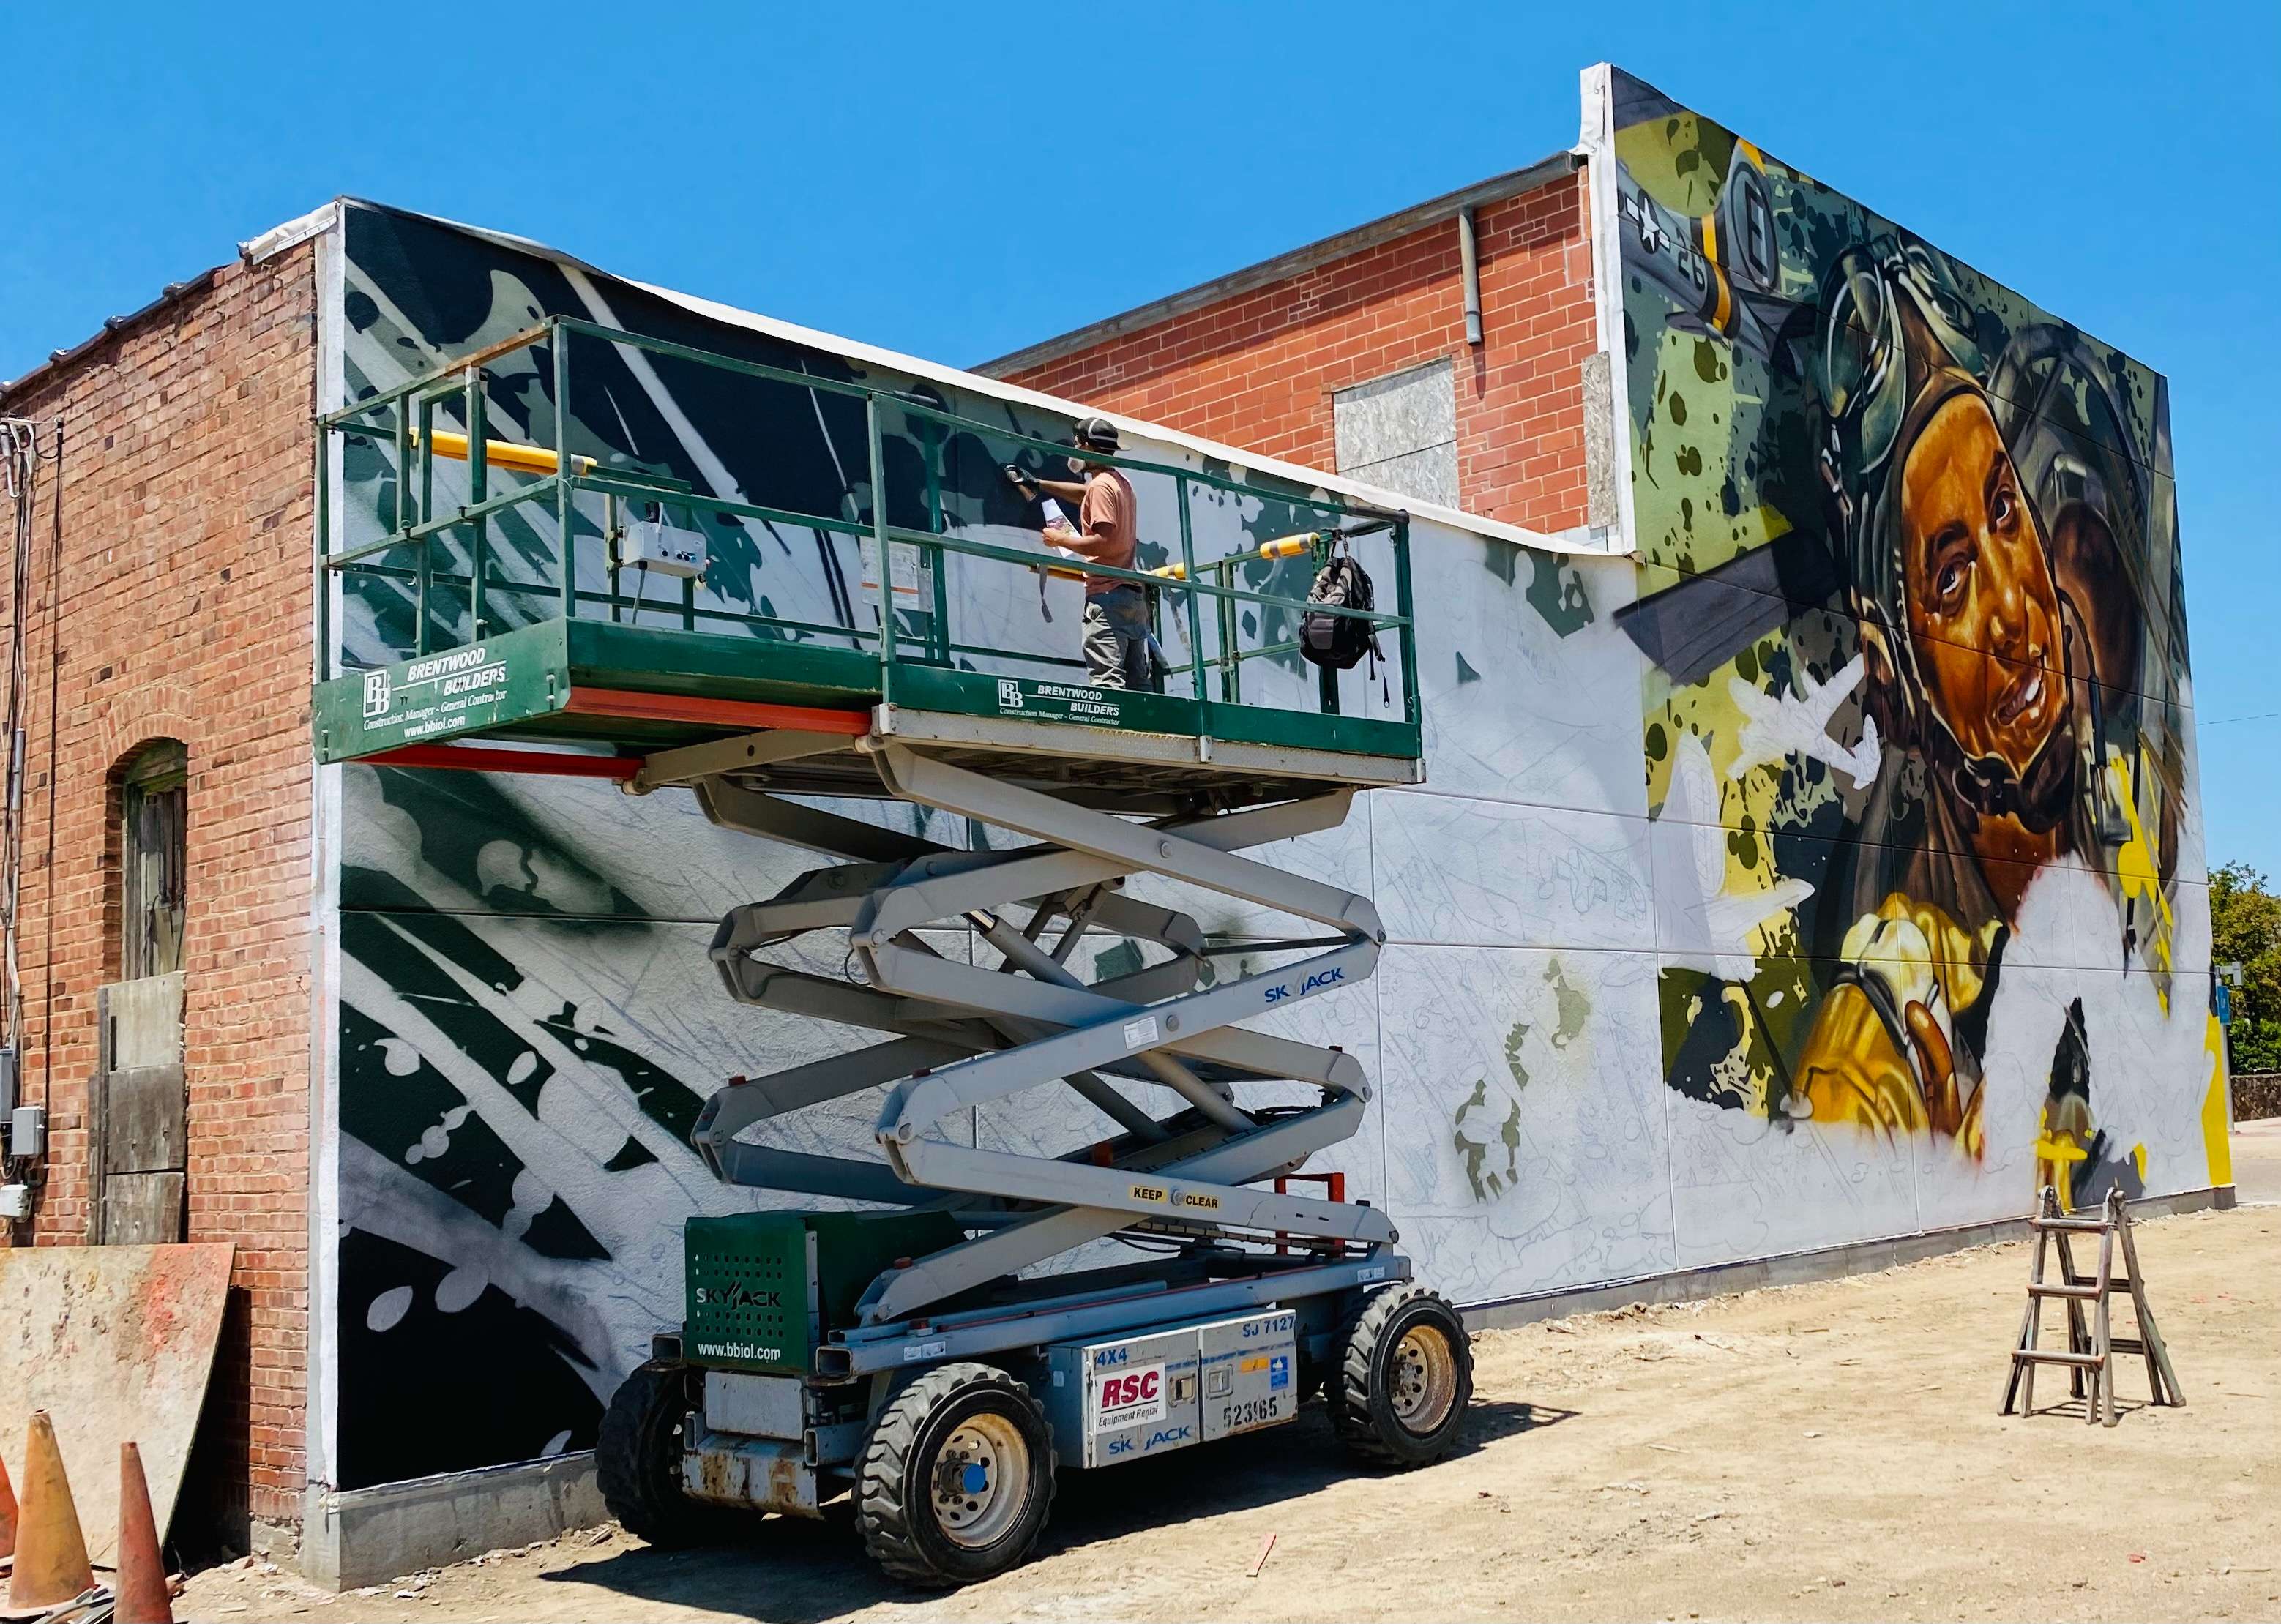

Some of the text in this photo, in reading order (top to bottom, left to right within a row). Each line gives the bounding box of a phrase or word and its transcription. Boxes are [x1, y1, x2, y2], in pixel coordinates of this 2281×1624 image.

[407, 647, 486, 682] BRENTWOOD
[443, 666, 507, 696] BUILDERS
[1037, 684, 1102, 701] BRENTWOOD
[363, 713, 404, 731] Construction
[405, 706, 436, 722] Manager
[441, 696, 466, 714] General
[999, 707, 1038, 717] Construction
[1039, 710, 1064, 720] Manager
[1068, 714, 1089, 722] General
[1091, 716, 1121, 726] Contractor
[1070, 702, 1119, 716] BUILDERS
[403, 715, 466, 738] www.bbiol.com
[1133, 1187, 1218, 1208] KEEP CLEAR
[696, 1281, 781, 1311] SKYJACK
[1242, 1316, 1295, 1338] SJ 7127
[698, 1342, 781, 1361] www.bbiol.com
[1097, 1347, 1128, 1366] 4X4
[1102, 1371, 1160, 1408] RSC
[1099, 1405, 1159, 1428] Equipment Rental
